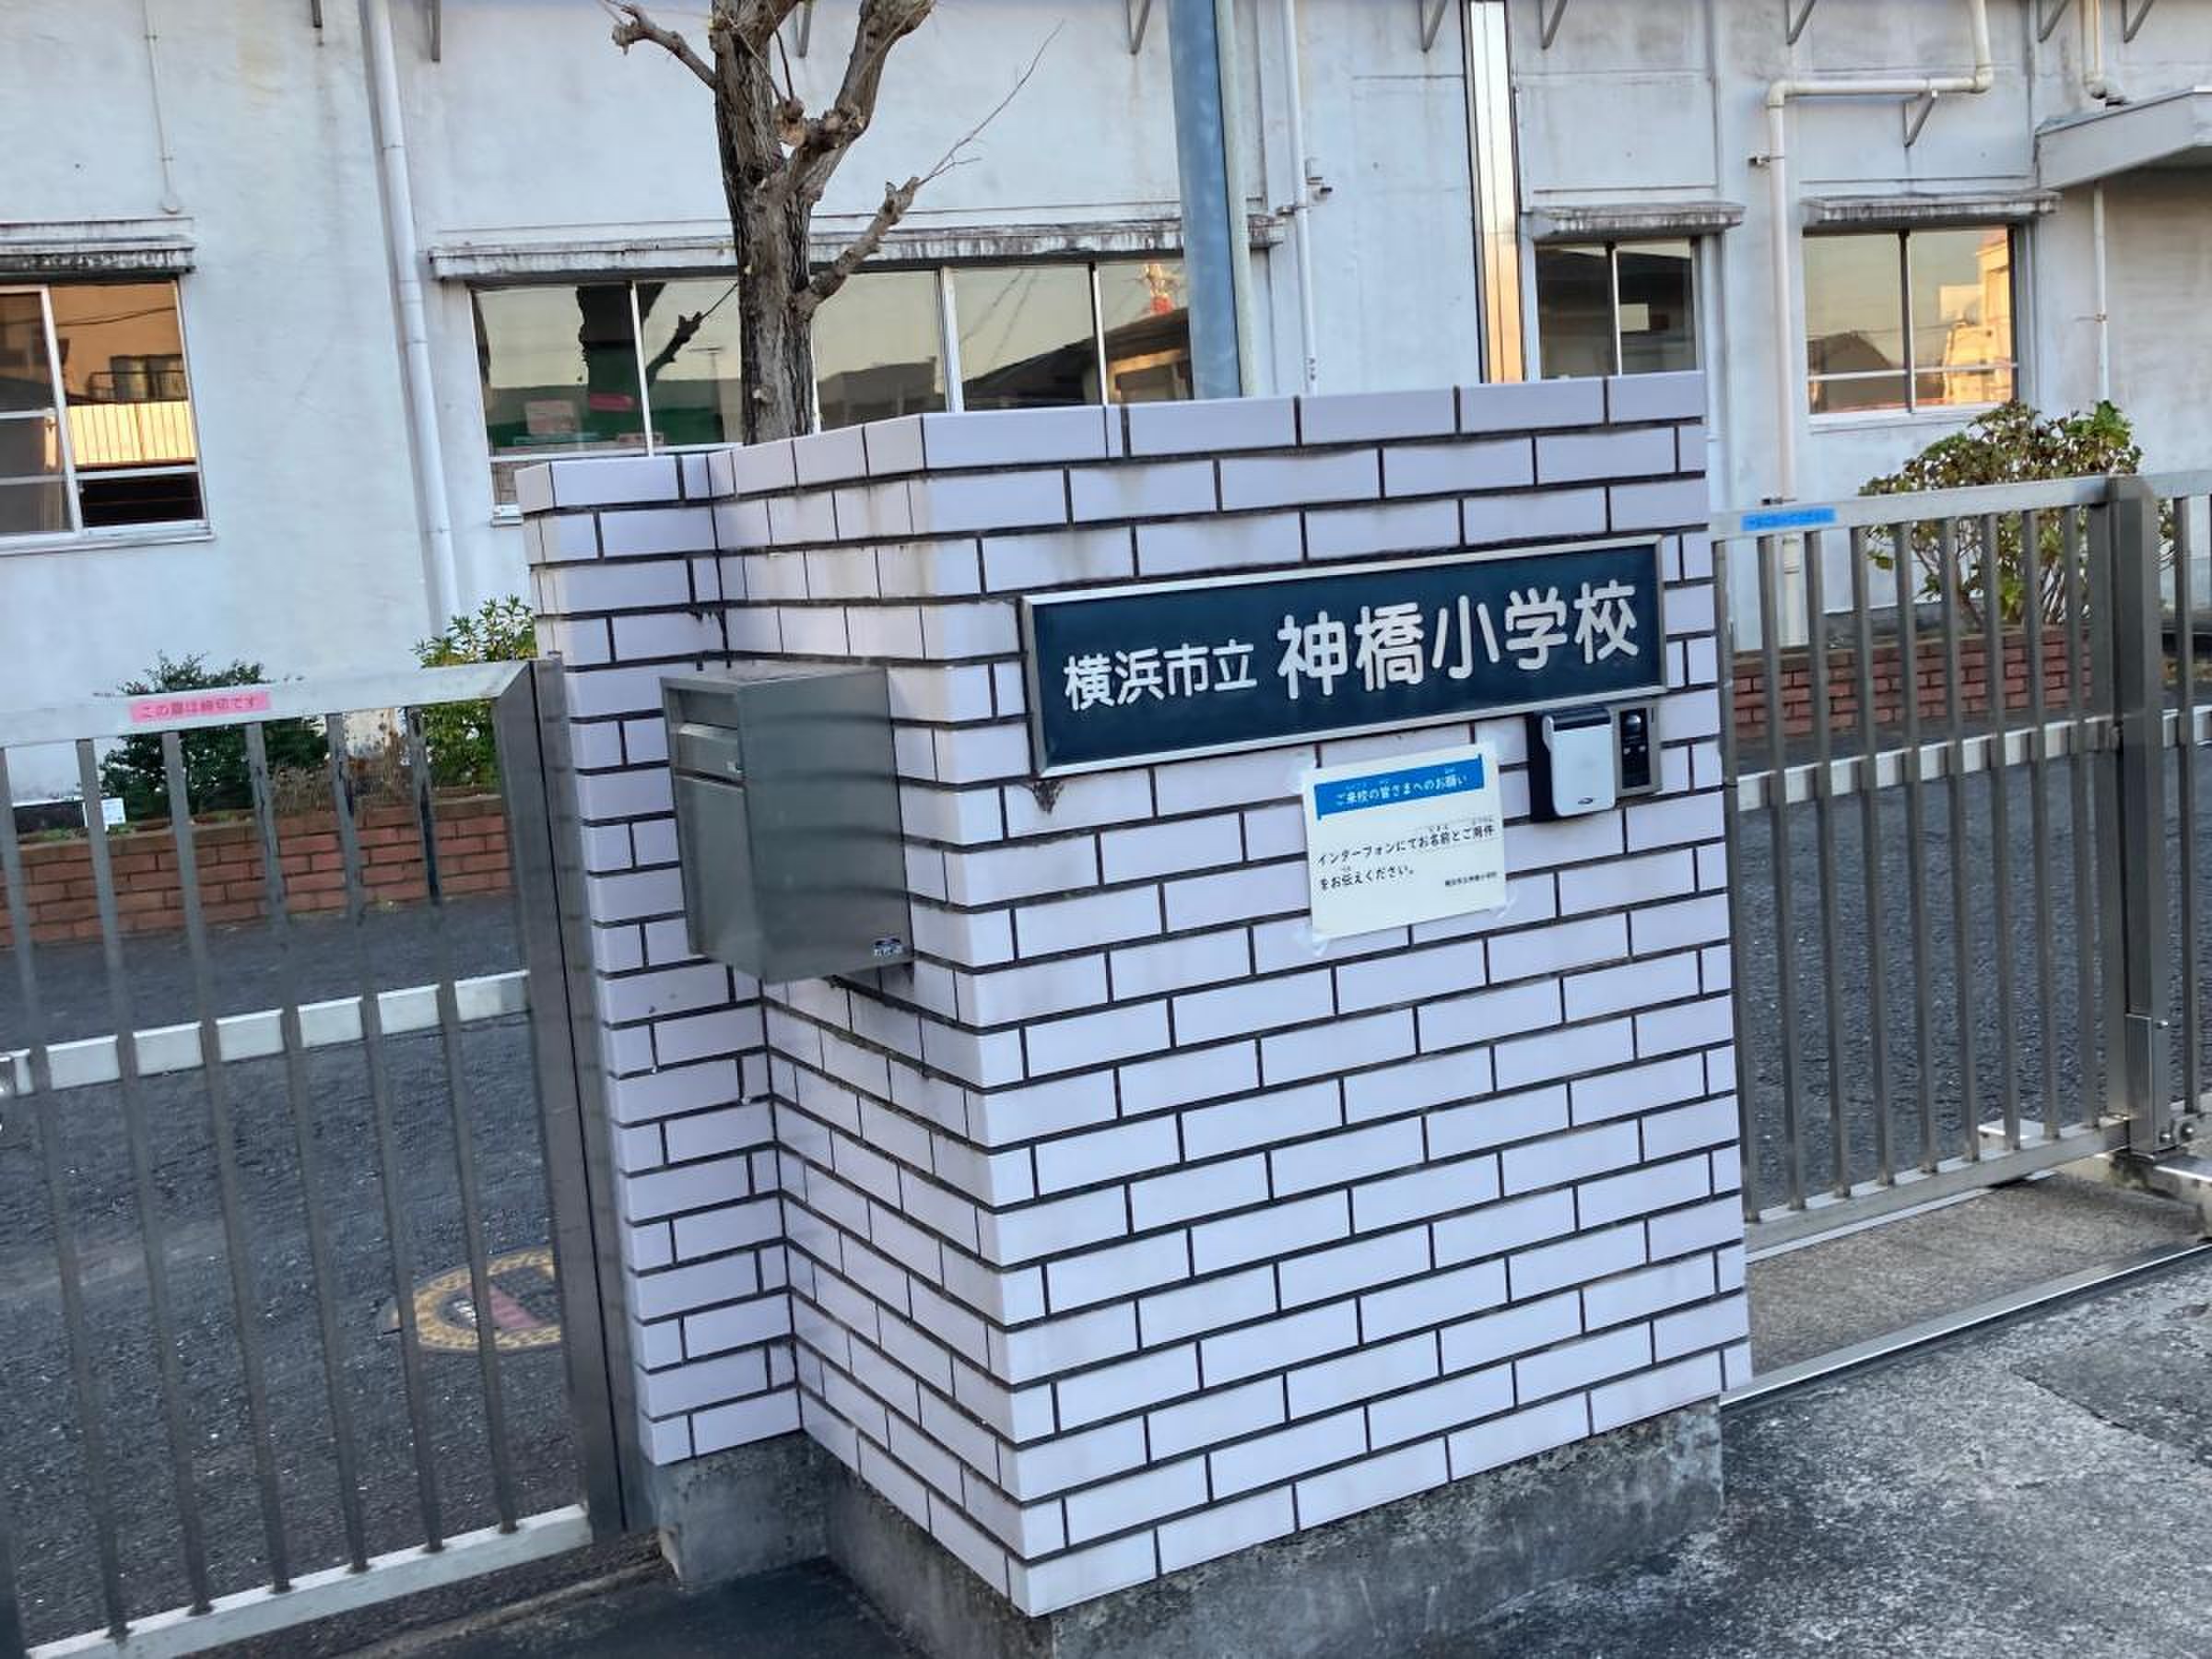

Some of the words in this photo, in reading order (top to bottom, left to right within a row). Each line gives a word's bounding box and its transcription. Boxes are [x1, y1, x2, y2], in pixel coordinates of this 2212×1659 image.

[1063, 638, 1258, 712] 横浜市立
[1277, 579, 1640, 700] 神橋小学校
[1317, 825, 1495, 867] インターフォンにてお名前とご用件
[1320, 864, 1415, 891] をお伝えください。
